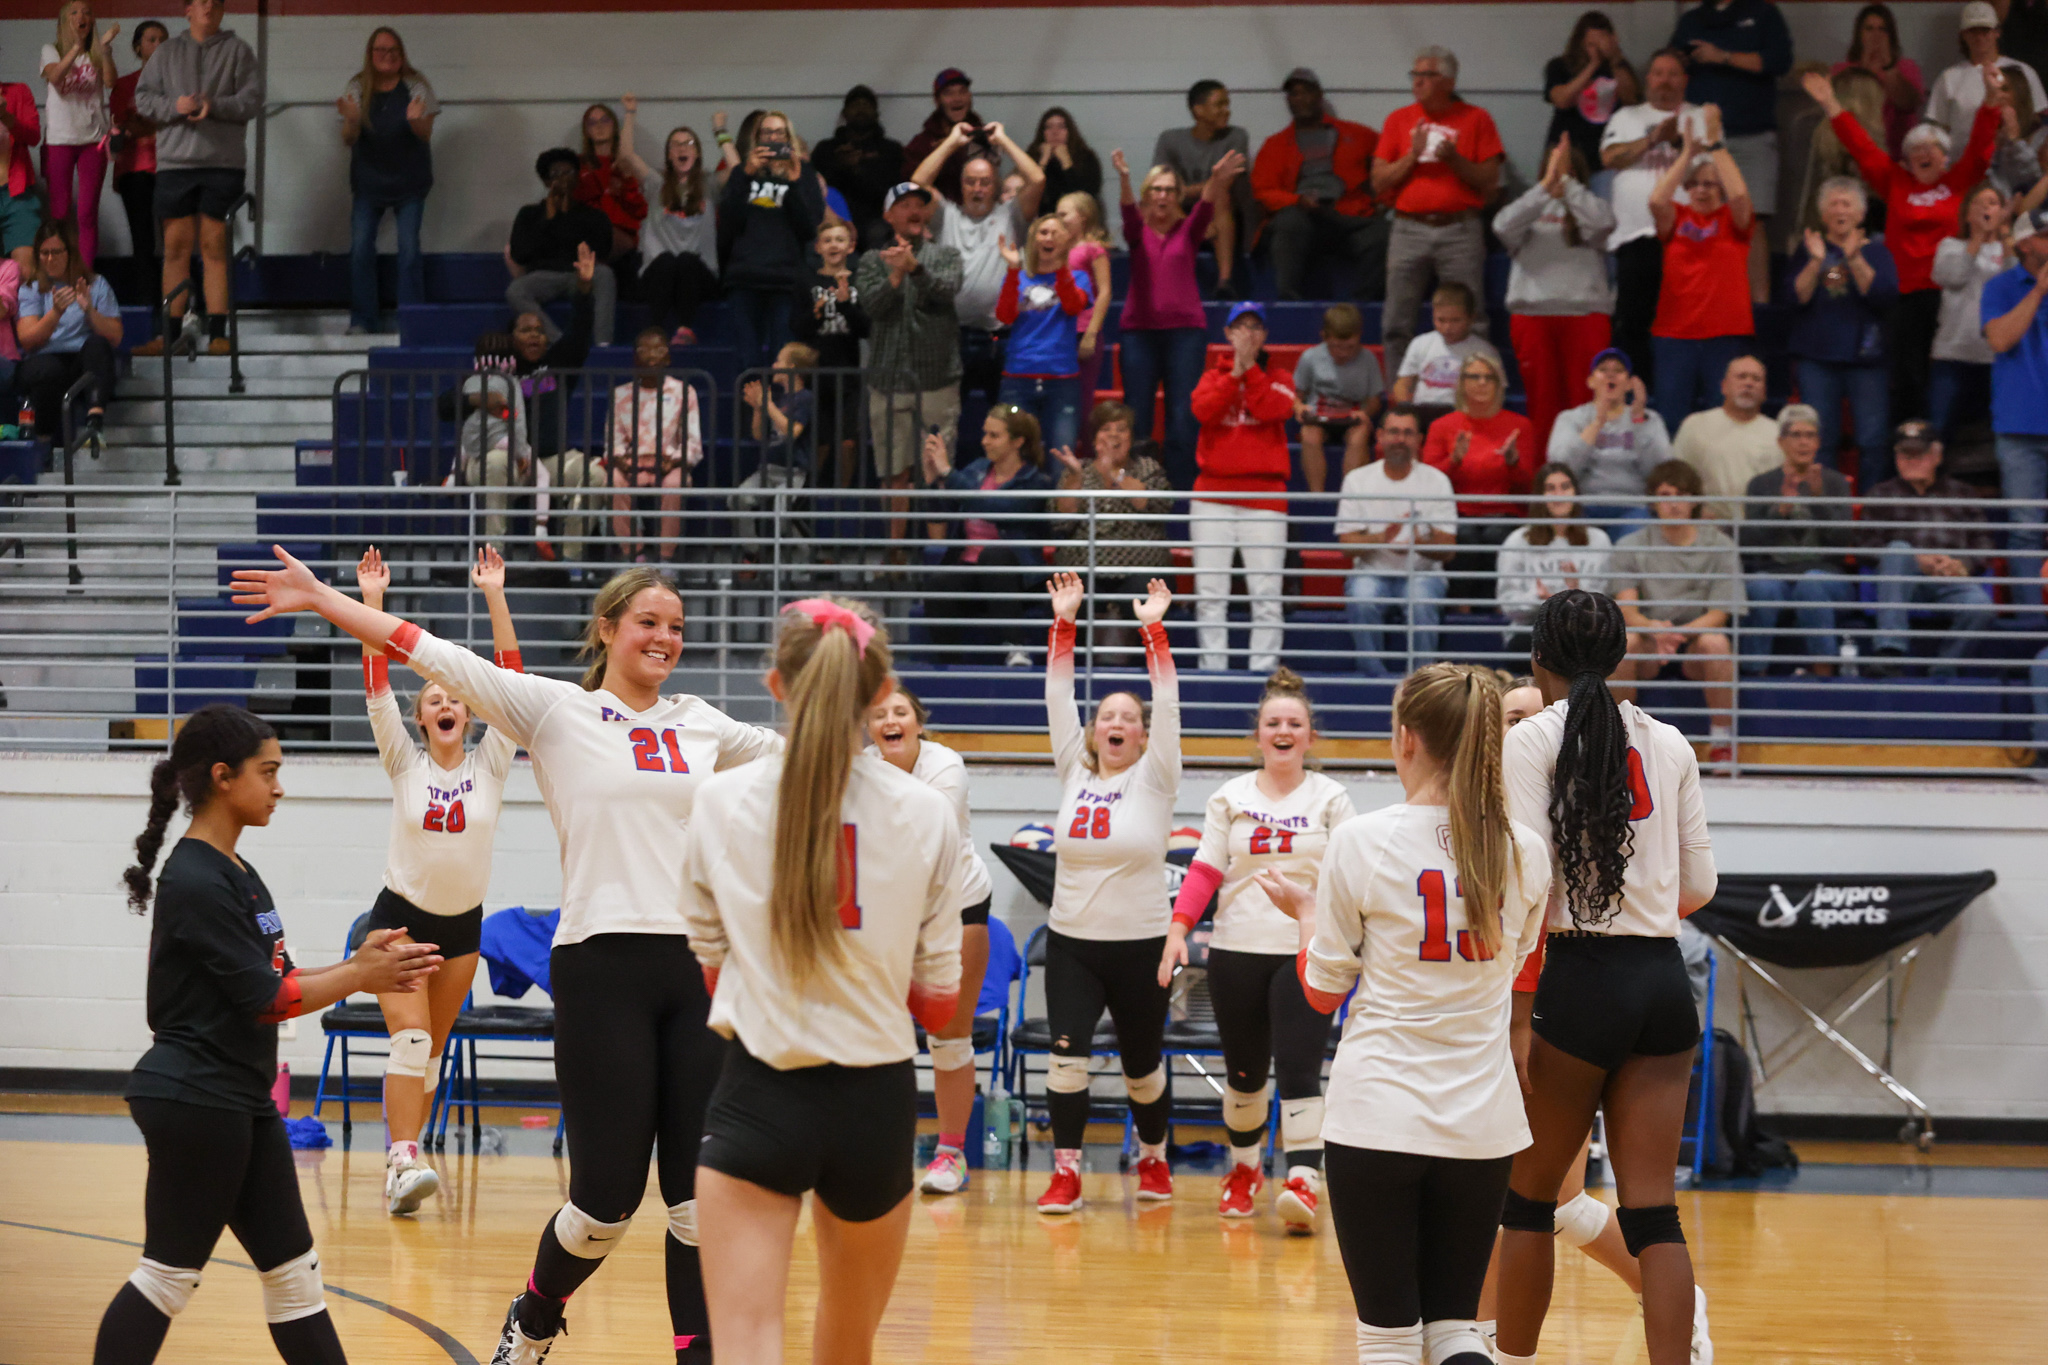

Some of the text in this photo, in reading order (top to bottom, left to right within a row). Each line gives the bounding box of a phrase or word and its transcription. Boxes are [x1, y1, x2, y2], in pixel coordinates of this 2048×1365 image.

[628, 727, 690, 774] 21
[423, 799, 466, 833] 20
[1068, 805, 1111, 840] 28
[1811, 883, 1890, 908] jaypro
[1811, 905, 1890, 929] sports
